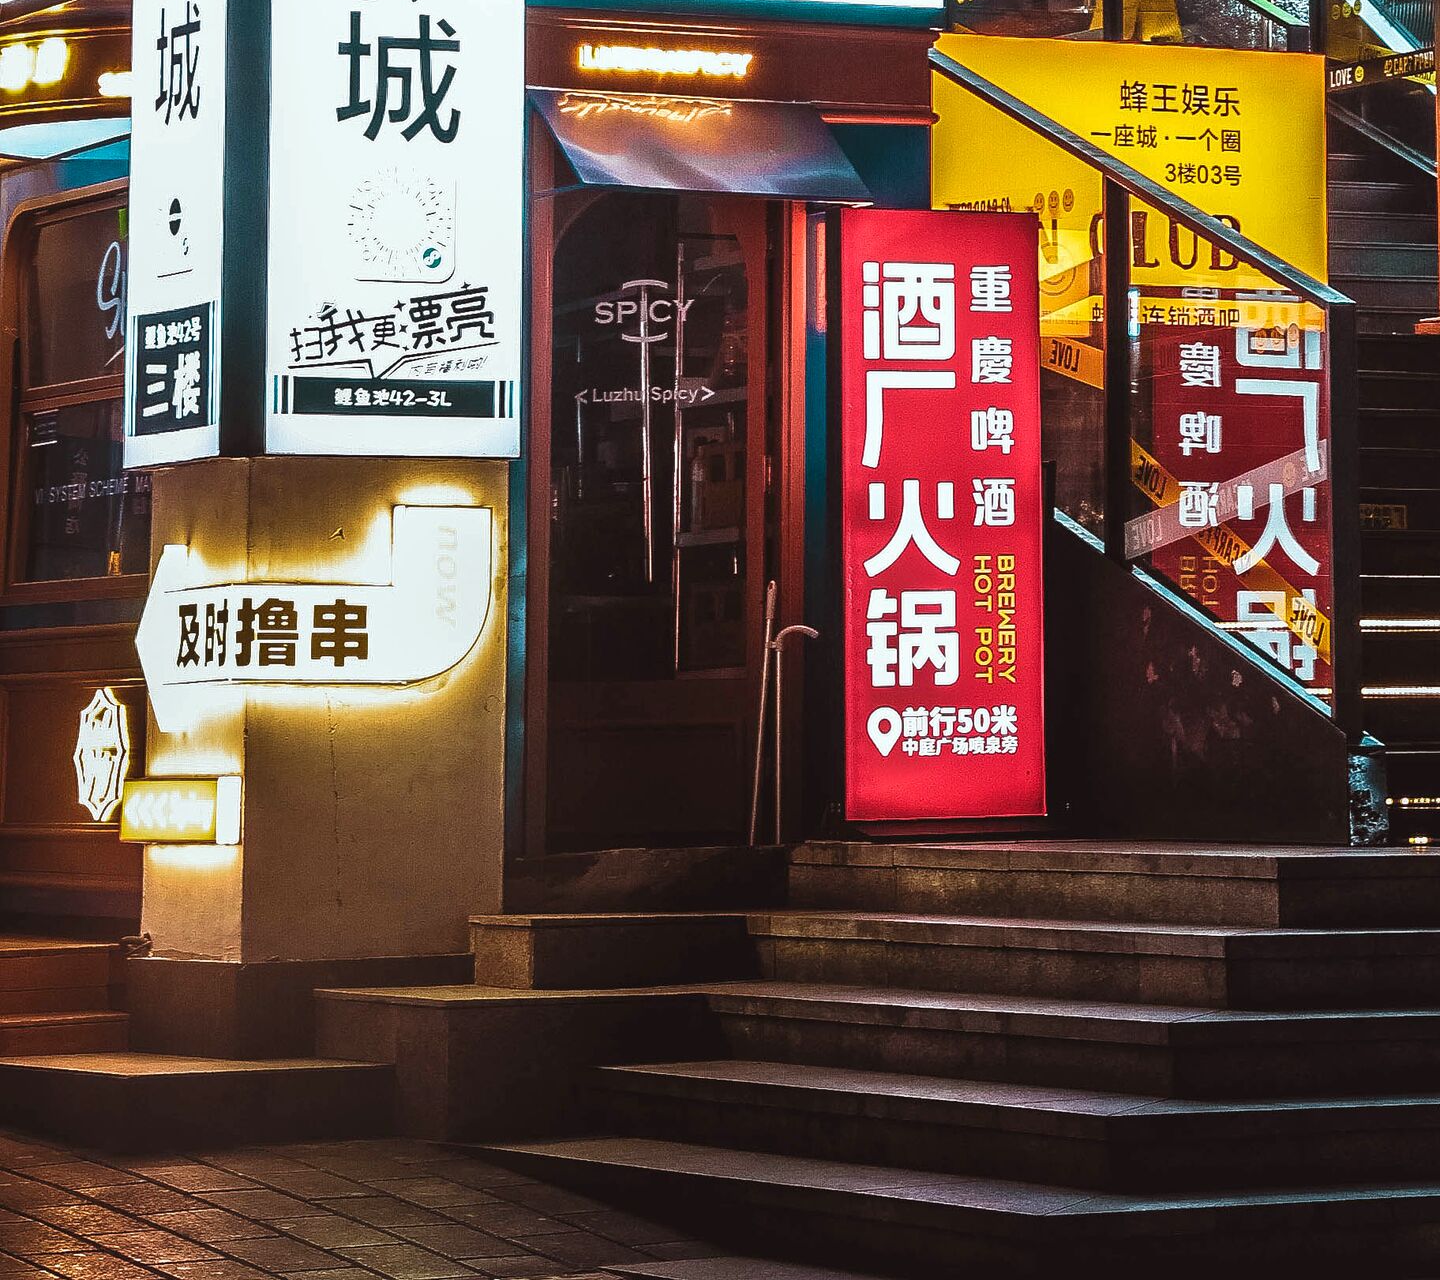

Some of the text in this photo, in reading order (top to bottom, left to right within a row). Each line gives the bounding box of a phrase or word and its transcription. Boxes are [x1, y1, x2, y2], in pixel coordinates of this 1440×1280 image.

[1330, 67, 1352, 88] LOVE
[1120, 80, 1242, 117] 蜂王娱乐
[1164, 162, 1243, 187] 3楼03号
[594, 299, 697, 325] SPICY
[142, 350, 202, 420] 三楼
[334, 387, 453, 408] 鲤鱼池42-3L
[592, 386, 642, 403] Luzhu
[969, 264, 1016, 527] 重慶啤酒
[48, 483, 86, 503] SYSTEM
[88, 477, 129, 498] SCHEME
[861, 260, 961, 688] 酒厂火锅
[176, 598, 369, 668] 及时撸串
[973, 554, 995, 685] HOT POT
[997, 554, 1017, 685] BREWERY
[902, 704, 1018, 737] 前行50米
[902, 736, 1018, 757] 中庭广场喷泉旁
